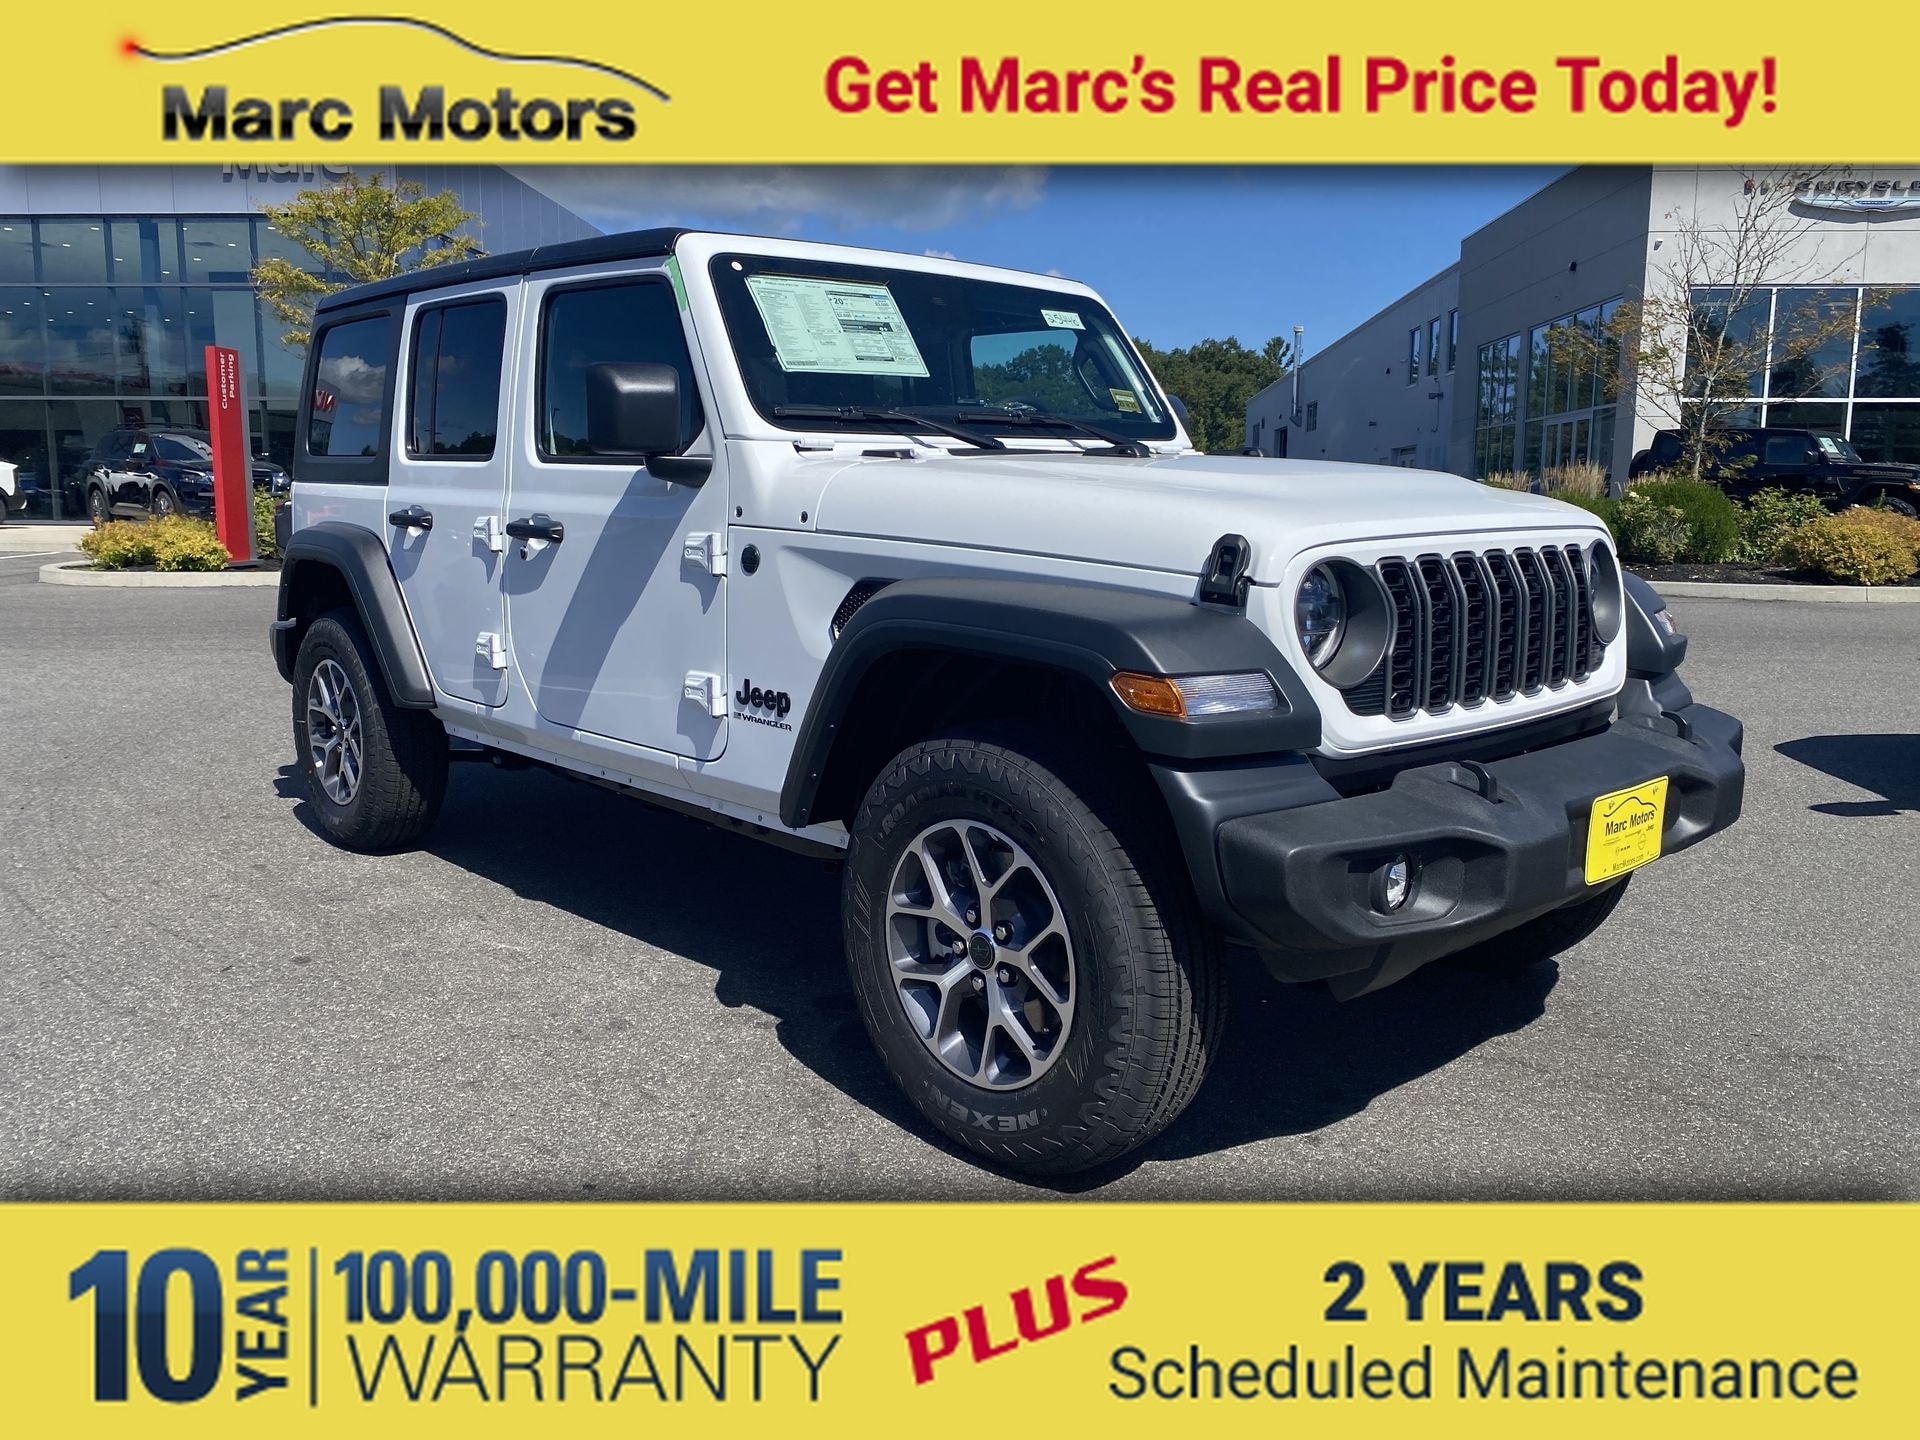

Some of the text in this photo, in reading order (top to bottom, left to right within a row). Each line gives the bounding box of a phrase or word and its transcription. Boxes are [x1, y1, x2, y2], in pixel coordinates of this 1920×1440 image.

[220, 352, 228, 410] Customer
[736, 679, 791, 718] Jeep
[742, 713, 792, 731] WRANGLER
[1605, 809, 1655, 836] Marc Motors
[929, 1084, 1040, 1132] NEXEN
